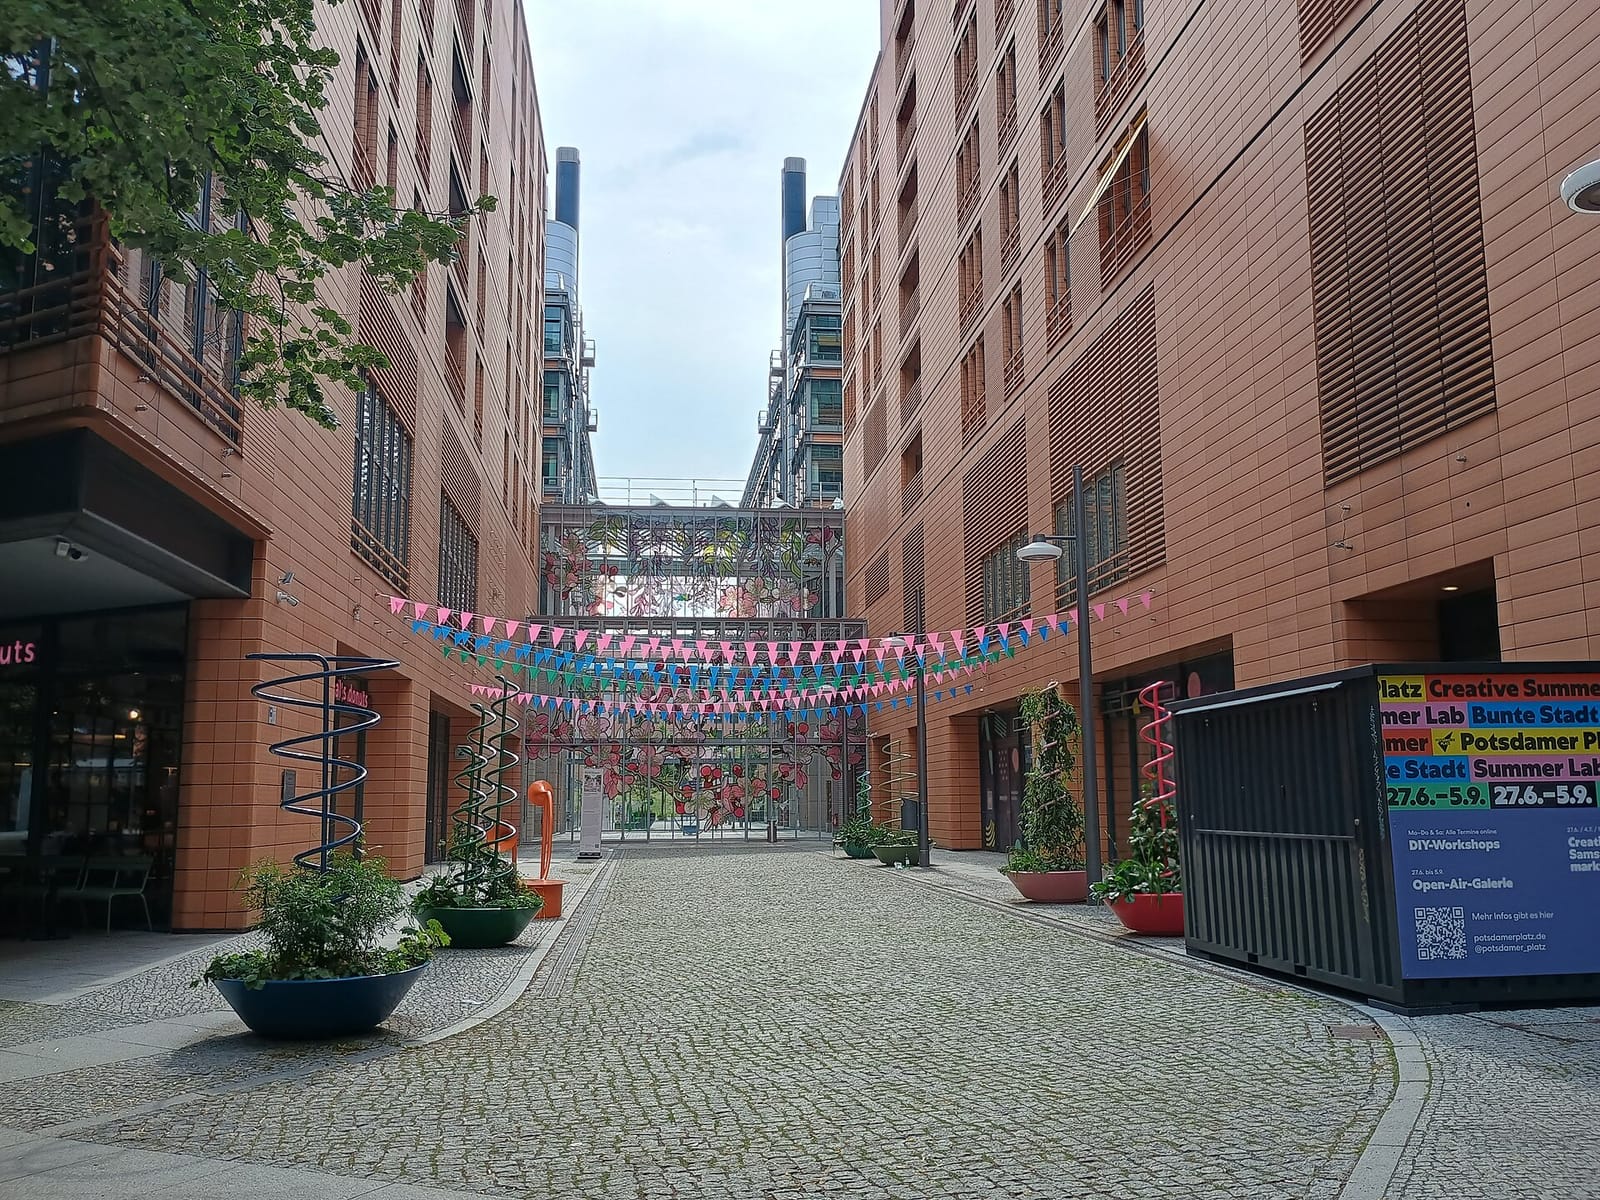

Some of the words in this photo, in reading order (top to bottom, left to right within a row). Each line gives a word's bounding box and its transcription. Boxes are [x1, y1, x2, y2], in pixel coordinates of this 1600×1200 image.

[0, 640, 35, 665] uts
[1377, 679, 1422, 698] latz
[1429, 678, 1519, 698] Creative
[1523, 678, 1600, 697] Summe
[1425, 706, 1465, 724] Lab
[1472, 706, 1536, 724] Bunte
[1539, 705, 1599, 723] Stadt
[1382, 736, 1428, 752] mer
[1460, 732, 1578, 751] Potsdamer
[1404, 760, 1466, 779] Stadt
[1473, 759, 1563, 778] Summer
[1409, 839, 1500, 852] DIY-Workshops
[1412, 878, 1514, 892] Open-Air-Galerie
[1471, 912, 1493, 920] Mehr
[1494, 912, 1512, 920] Infos
[1513, 911, 1528, 921] gibt
[1539, 911, 1554, 919] hier
[1474, 933, 1547, 943] potsdamerplatz.de
[1475, 943, 1547, 954] @potsdamer_platz
